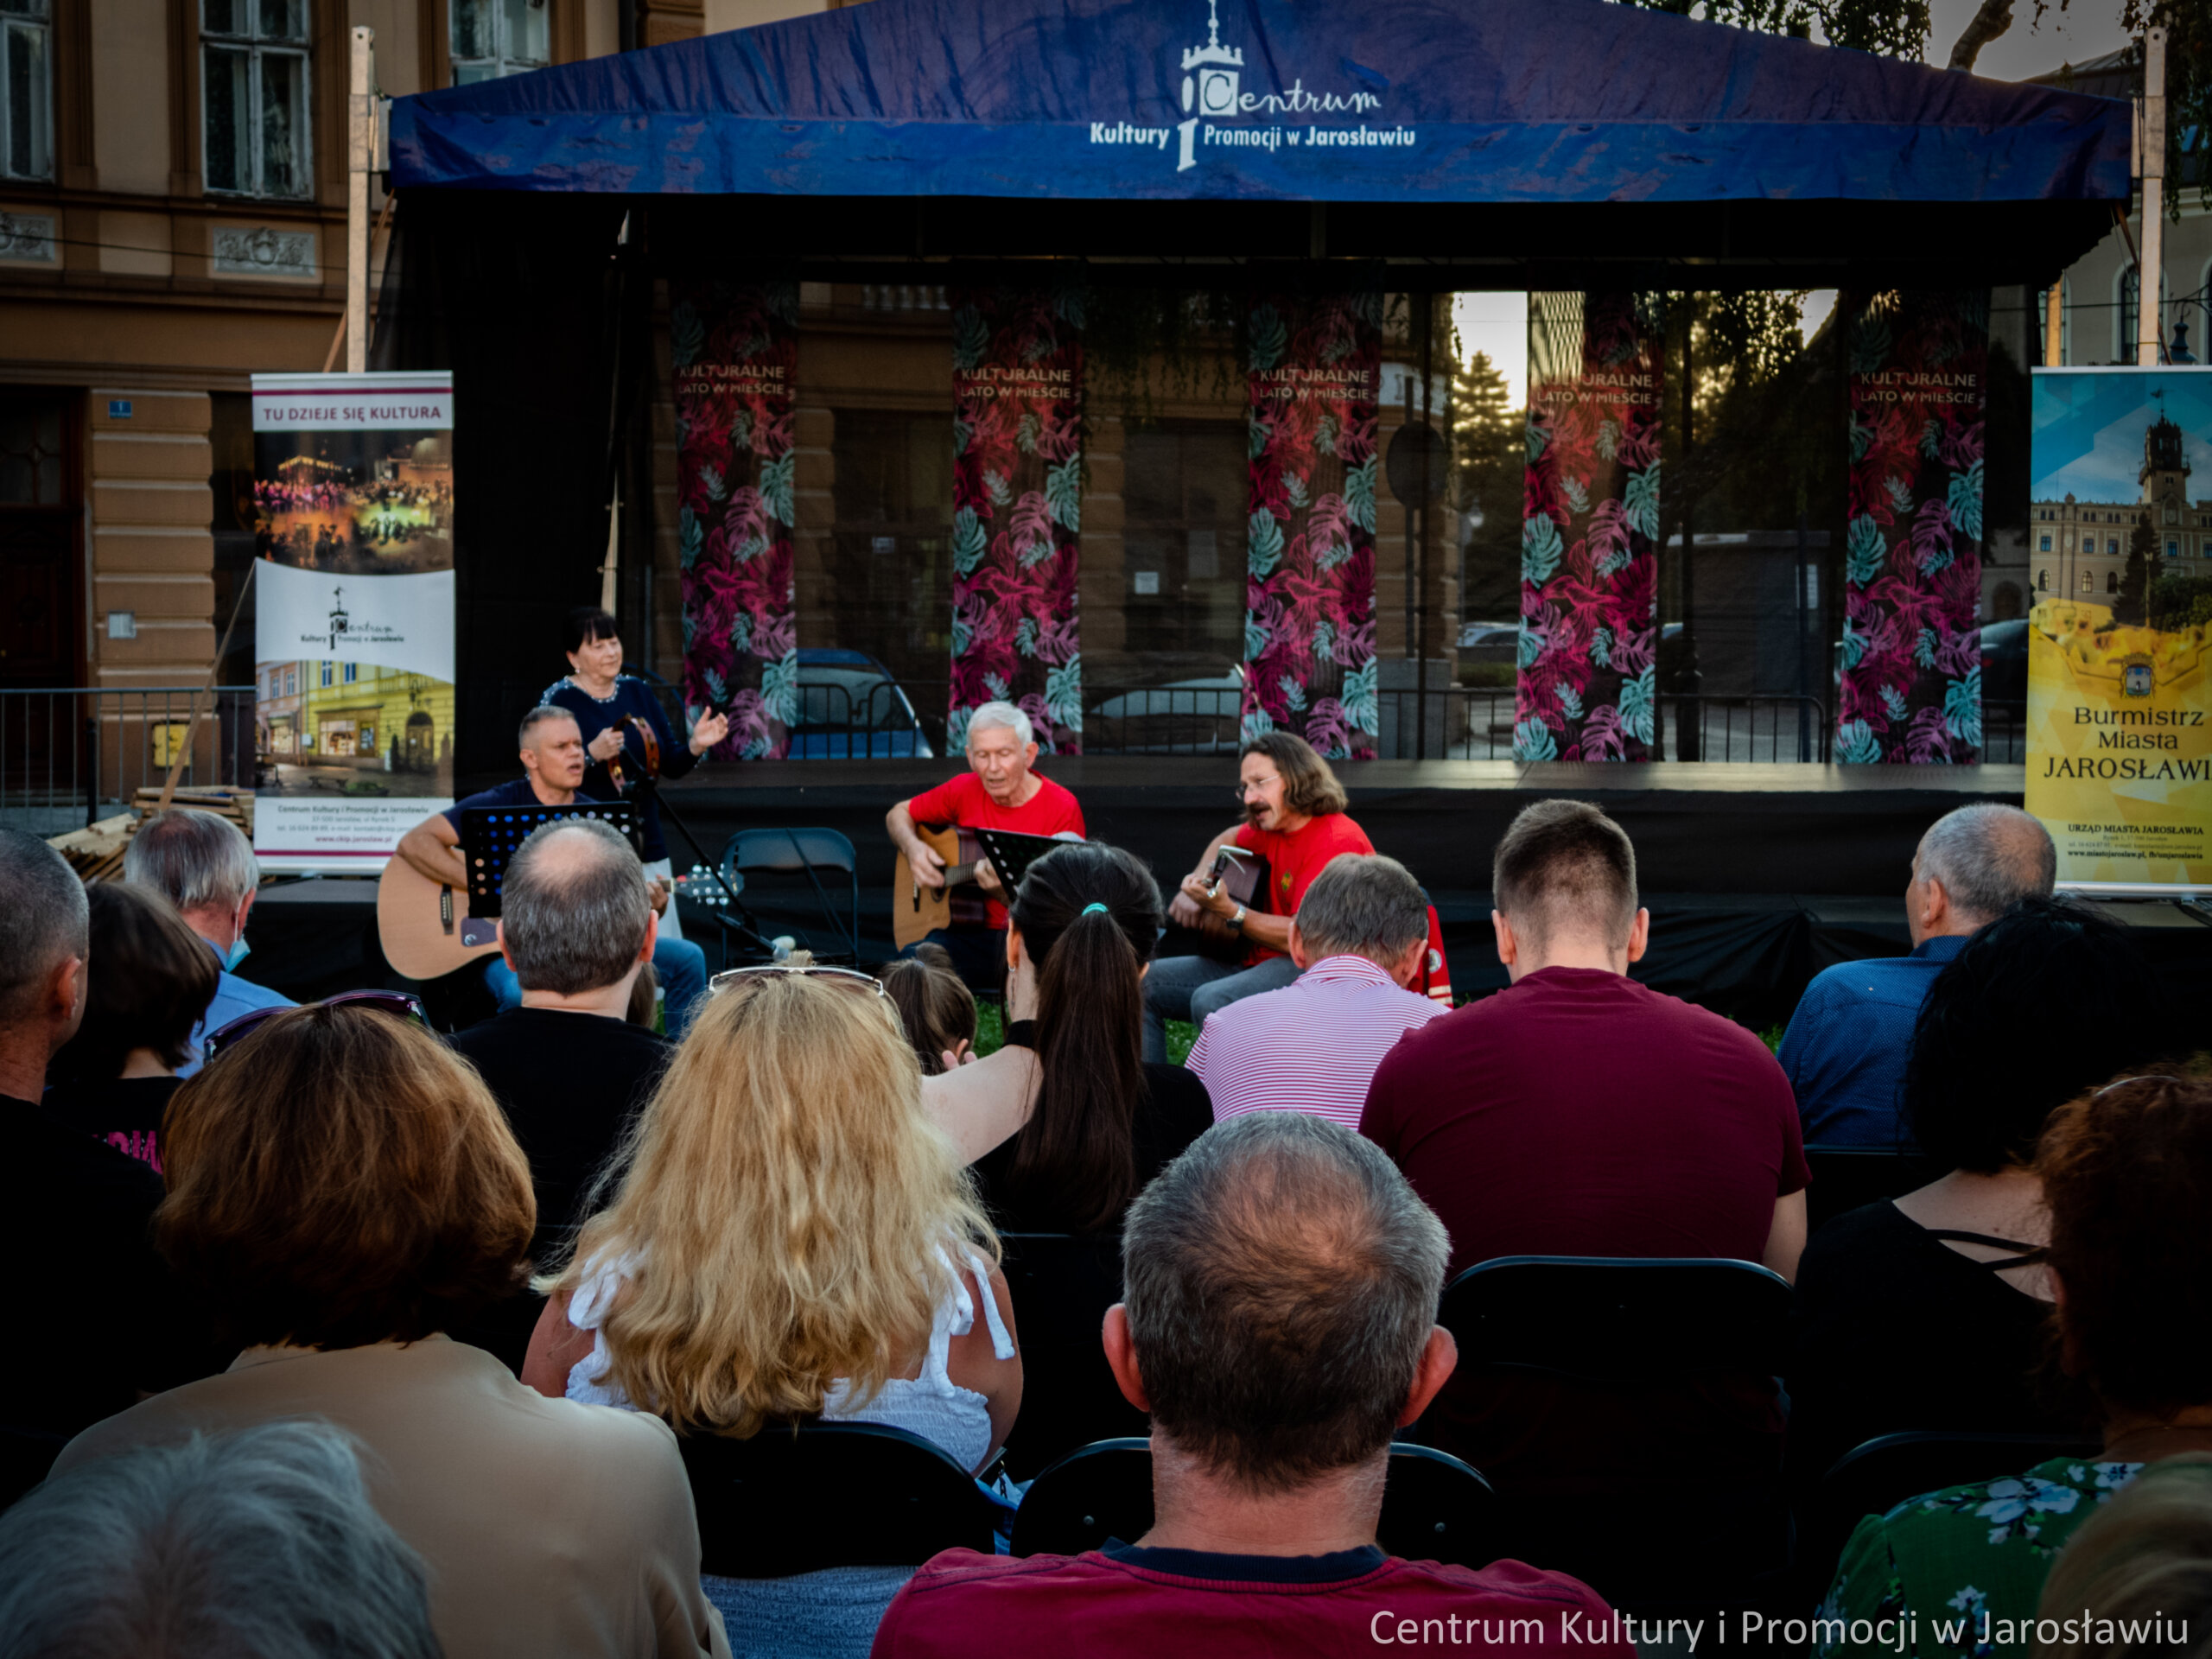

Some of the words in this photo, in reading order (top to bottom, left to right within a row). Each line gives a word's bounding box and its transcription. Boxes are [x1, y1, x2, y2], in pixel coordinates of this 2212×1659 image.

[1200, 69, 1382, 116] Centrum
[1090, 122, 1170, 149] Kultury
[1204, 124, 1281, 153] Promocji
[1287, 130, 1300, 146] w
[1305, 124, 1416, 147] Jarosławiu
[962, 367, 1071, 382] KULTURALNE
[1260, 369, 1370, 383] KULTURALNE
[1861, 372, 1977, 387] KULTURALNE
[678, 383, 709, 394] LATO
[713, 383, 726, 394] W
[961, 386, 995, 397] LATO
[999, 386, 1012, 397] W
[1260, 387, 1293, 398] LATO
[1296, 387, 1311, 398] W
[1537, 391, 1573, 402] LATO
[1578, 391, 1592, 403] W
[1860, 391, 1897, 402] LATO
[1902, 391, 1916, 403] W
[264, 408, 283, 421] TU
[288, 407, 338, 421] DZIEJE
[343, 407, 365, 423] SIĘ
[370, 406, 442, 420] KULTURA
[2074, 707, 2204, 727] Burmistrz
[2098, 731, 2178, 750] Miasta
[2044, 757, 2212, 781] JAROSŁAWI
[313, 805, 340, 814] Kultury
[346, 805, 378, 815] Promocji
[2069, 823, 2101, 834] URZĄD
[2104, 824, 2140, 834] MIASTA
[2142, 825, 2204, 835] JAROSŁAWIA
